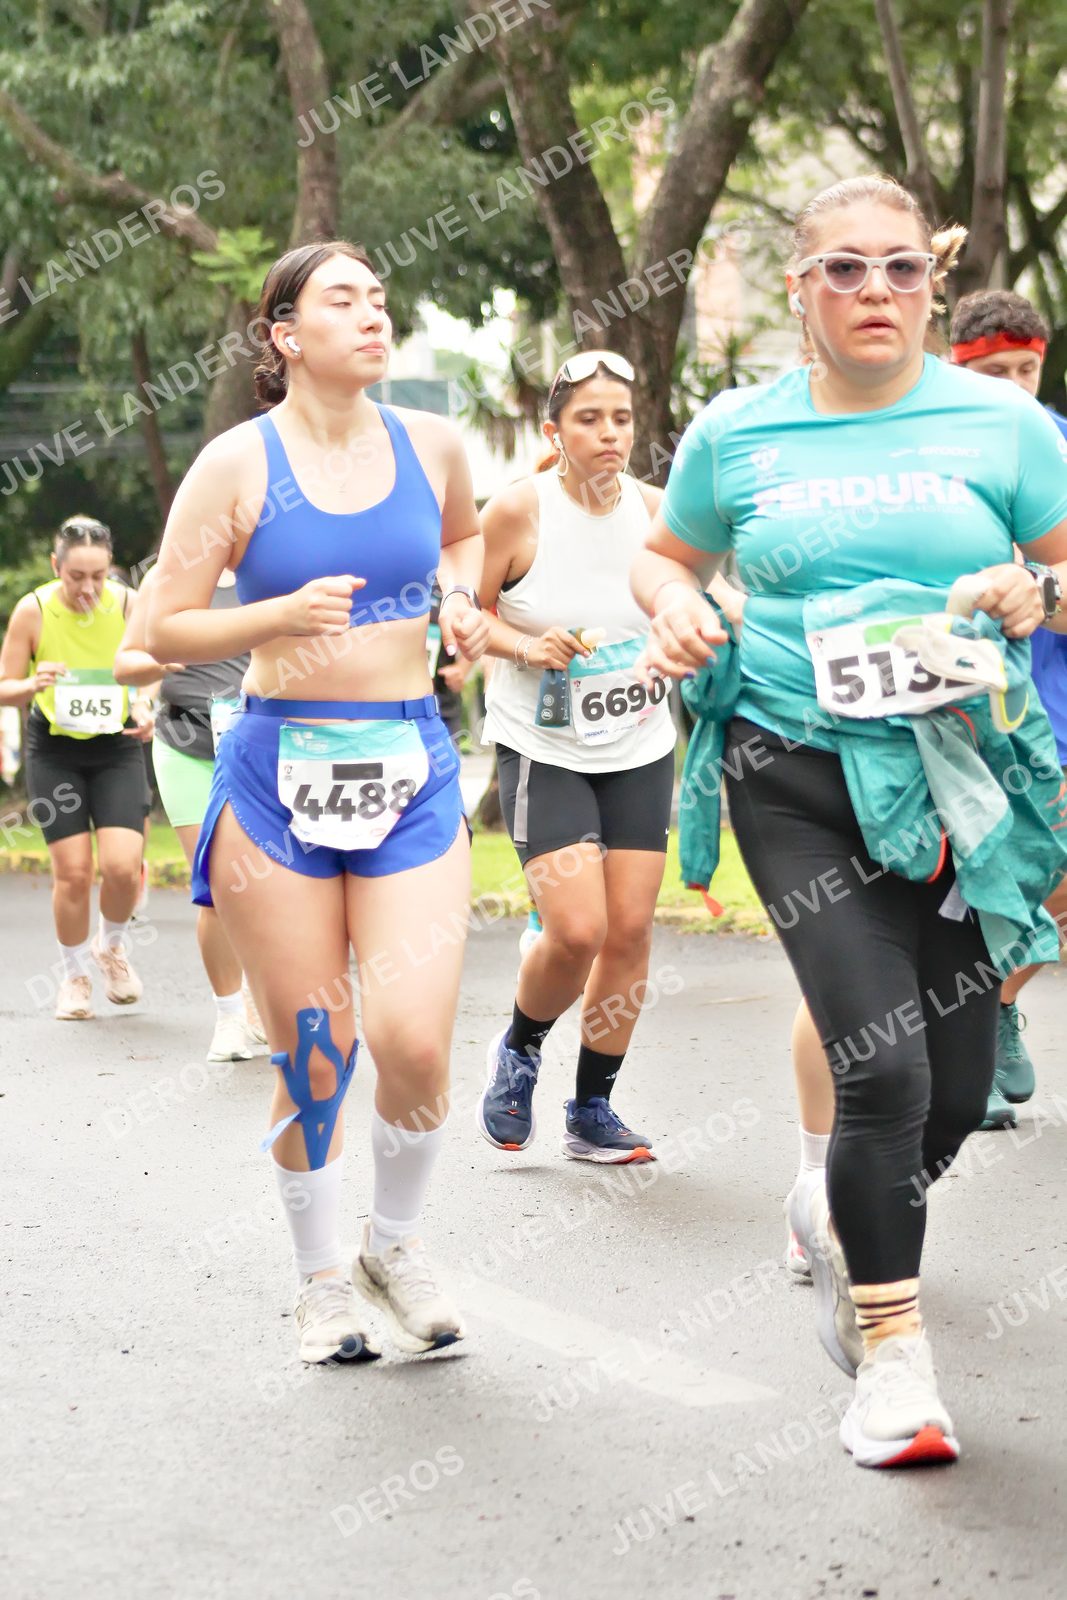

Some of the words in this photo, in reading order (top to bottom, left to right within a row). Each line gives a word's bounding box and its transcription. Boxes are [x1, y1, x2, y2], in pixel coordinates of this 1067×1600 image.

[581, 677, 666, 721] 6690
[823, 650, 978, 704] 513
[69, 699, 112, 717] 845
[293, 778, 417, 822] 4488
